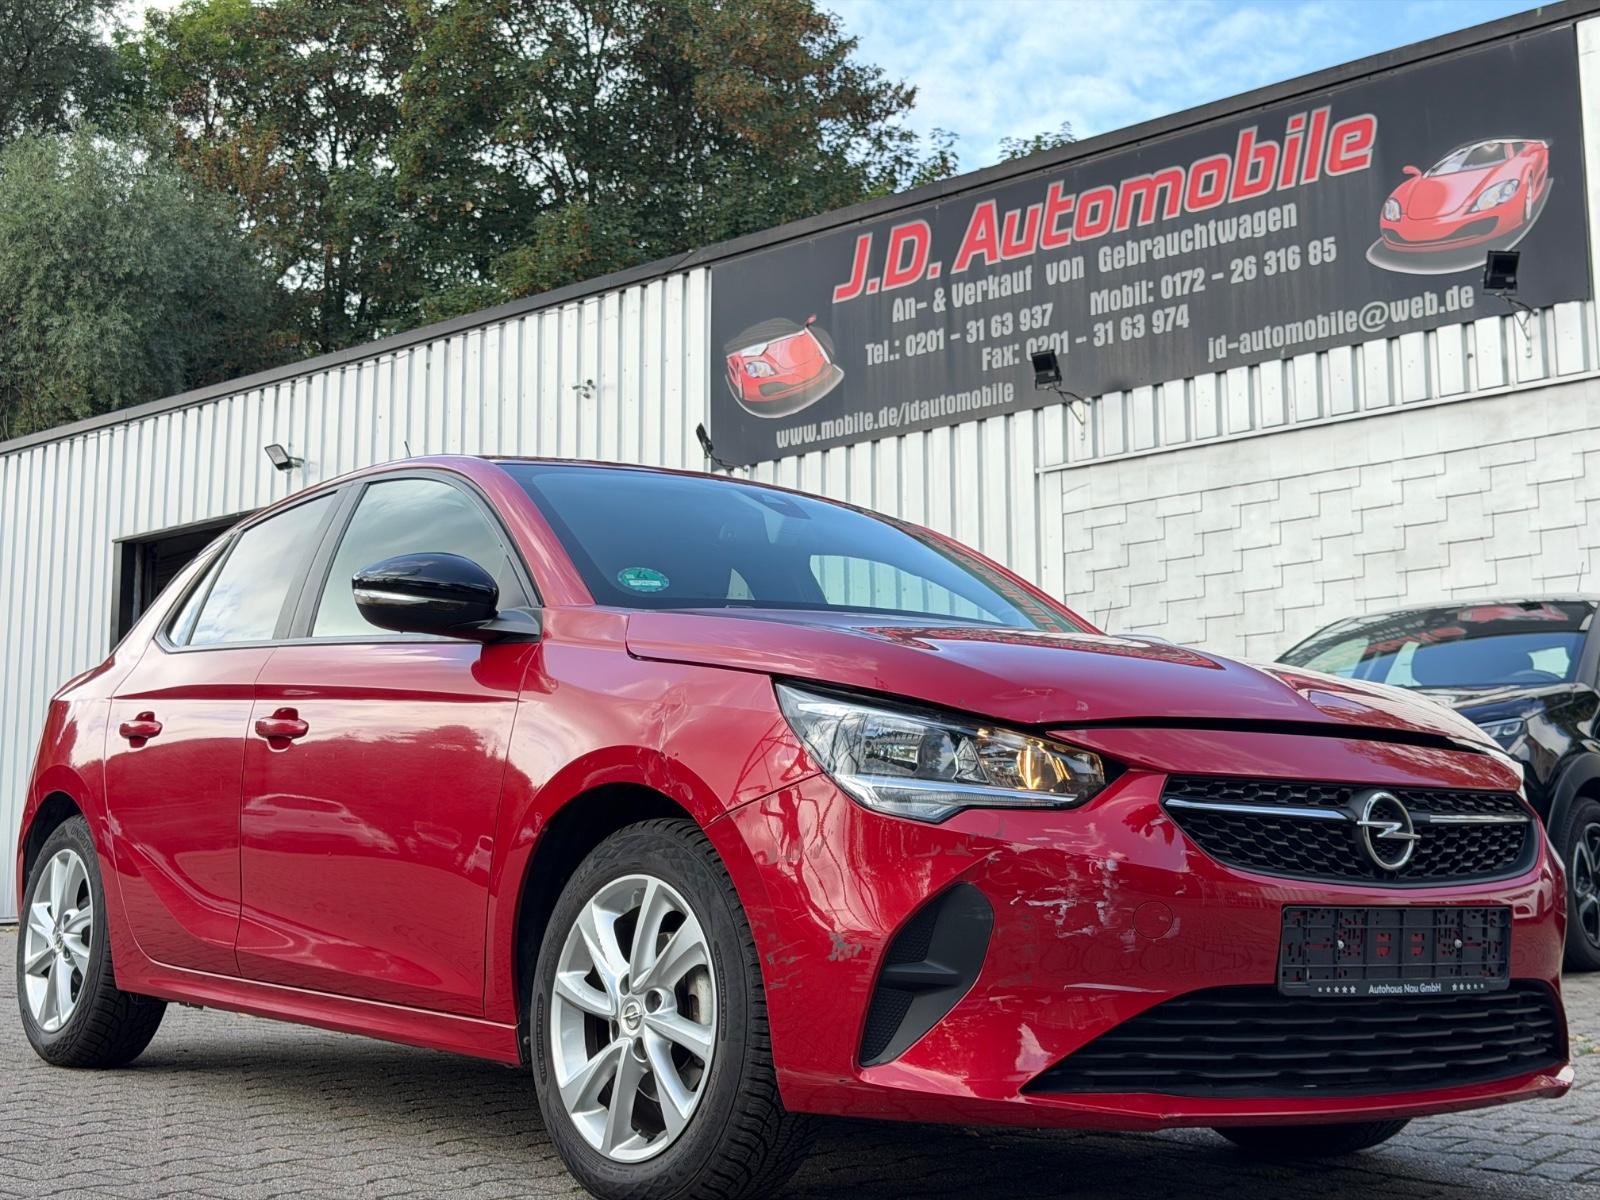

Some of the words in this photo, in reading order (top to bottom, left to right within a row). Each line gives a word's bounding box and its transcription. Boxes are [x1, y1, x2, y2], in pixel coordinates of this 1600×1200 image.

[832, 219, 942, 304] J.D.
[950, 104, 1378, 274] Automobile
[892, 297, 928, 323] An-
[933, 288, 946, 313] &
[952, 266, 1033, 308] Verkauf
[1045, 255, 1085, 286] von
[1098, 203, 1298, 273] Gebrauchtwagen
[1090, 279, 1154, 316] Mobil:
[1160, 267, 1206, 299] 0172
[1230, 255, 1257, 284] 26
[1264, 245, 1301, 275] 316
[1308, 237, 1337, 266] 85
[865, 340, 900, 366] Tel.:
[905, 327, 945, 358] 0201
[966, 317, 985, 344] 31
[990, 310, 1013, 338] 63
[1019, 302, 1054, 332] 937
[982, 342, 1020, 371] Fax:
[1093, 319, 1114, 348] 31
[1120, 312, 1145, 341] 63
[1152, 304, 1190, 336] 974
[1207, 284, 1475, 363] jd-automobile@web.de
[776, 382, 1014, 449] www.mobile.de/jdautomobile
[1368, 983, 1403, 994] Autohaus
[1403, 983, 1419, 993] Nau
[1420, 982, 1442, 993] GmbH
